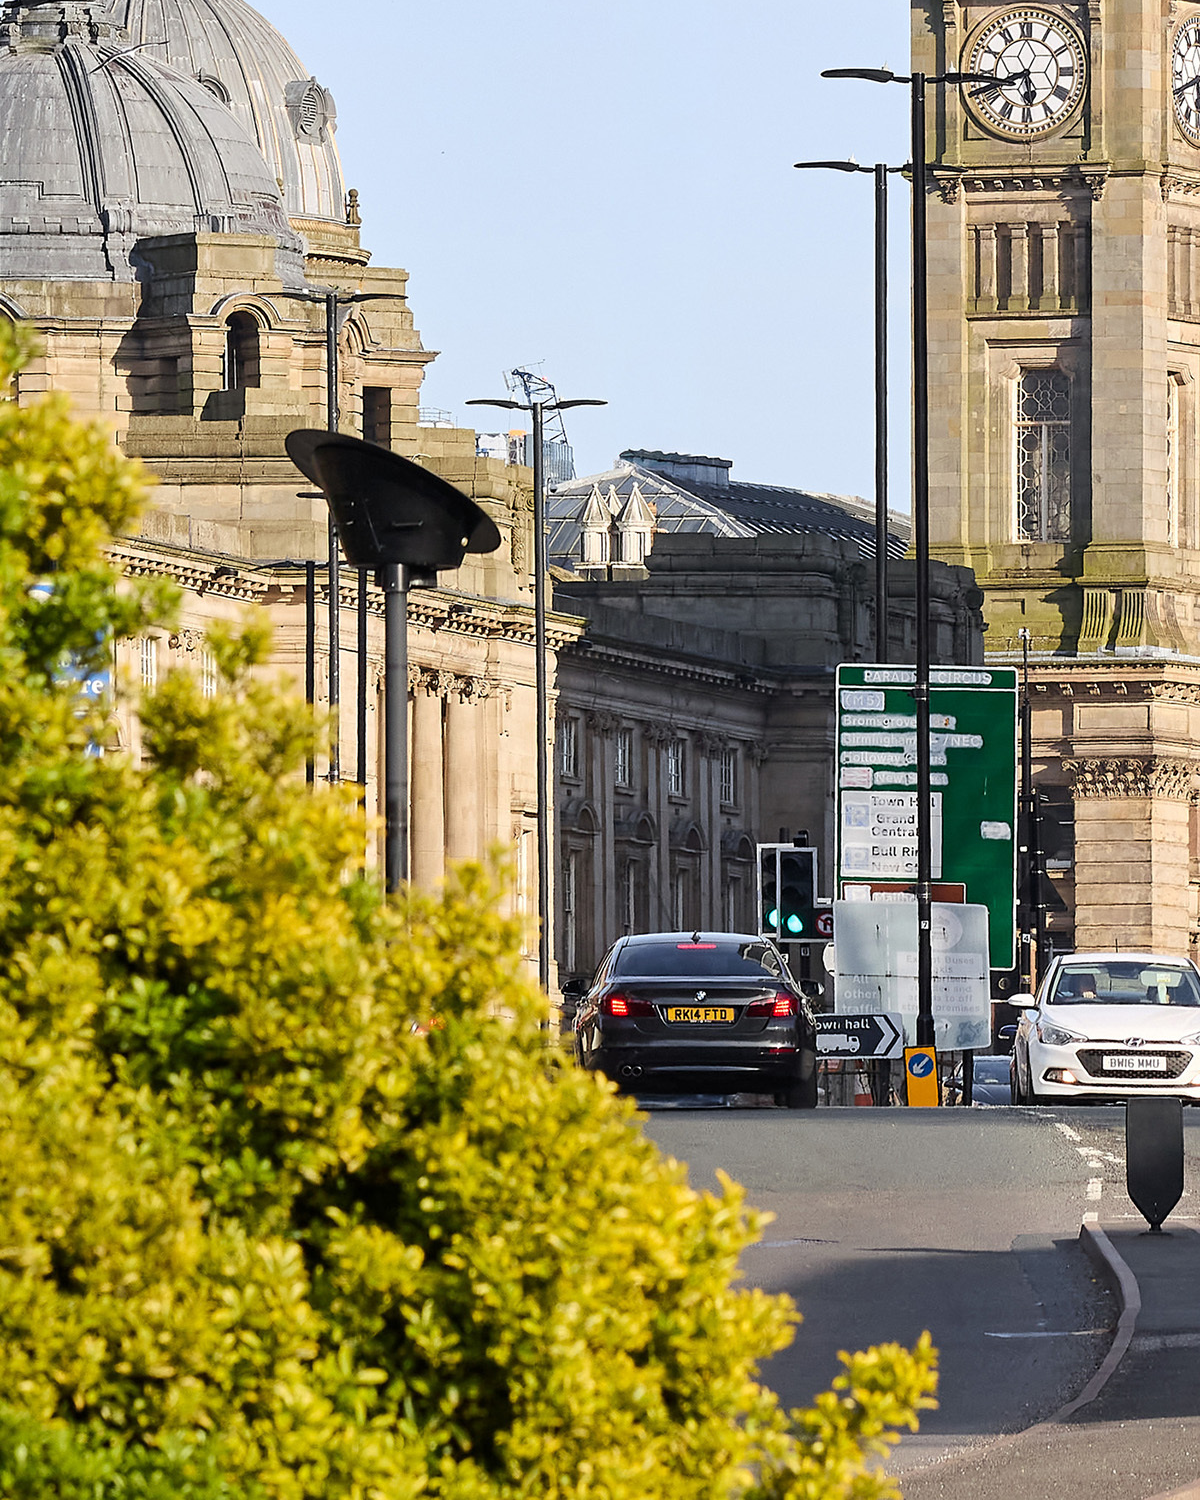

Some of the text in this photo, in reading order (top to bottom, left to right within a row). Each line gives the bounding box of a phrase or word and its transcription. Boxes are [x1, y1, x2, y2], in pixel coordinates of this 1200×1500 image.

[865, 670, 991, 684] PARADI CIRCUS
[872, 796, 936, 808] Town Hl
[877, 814, 915, 825] Grand
[872, 846, 896, 857] Bull
[872, 862, 900, 873] New
[844, 988, 878, 1000] other
[674, 1009, 727, 1020] RK14 FTD
[815, 1018, 871, 1030] own hall
[1110, 1058, 1159, 1068] BW16 MMU
